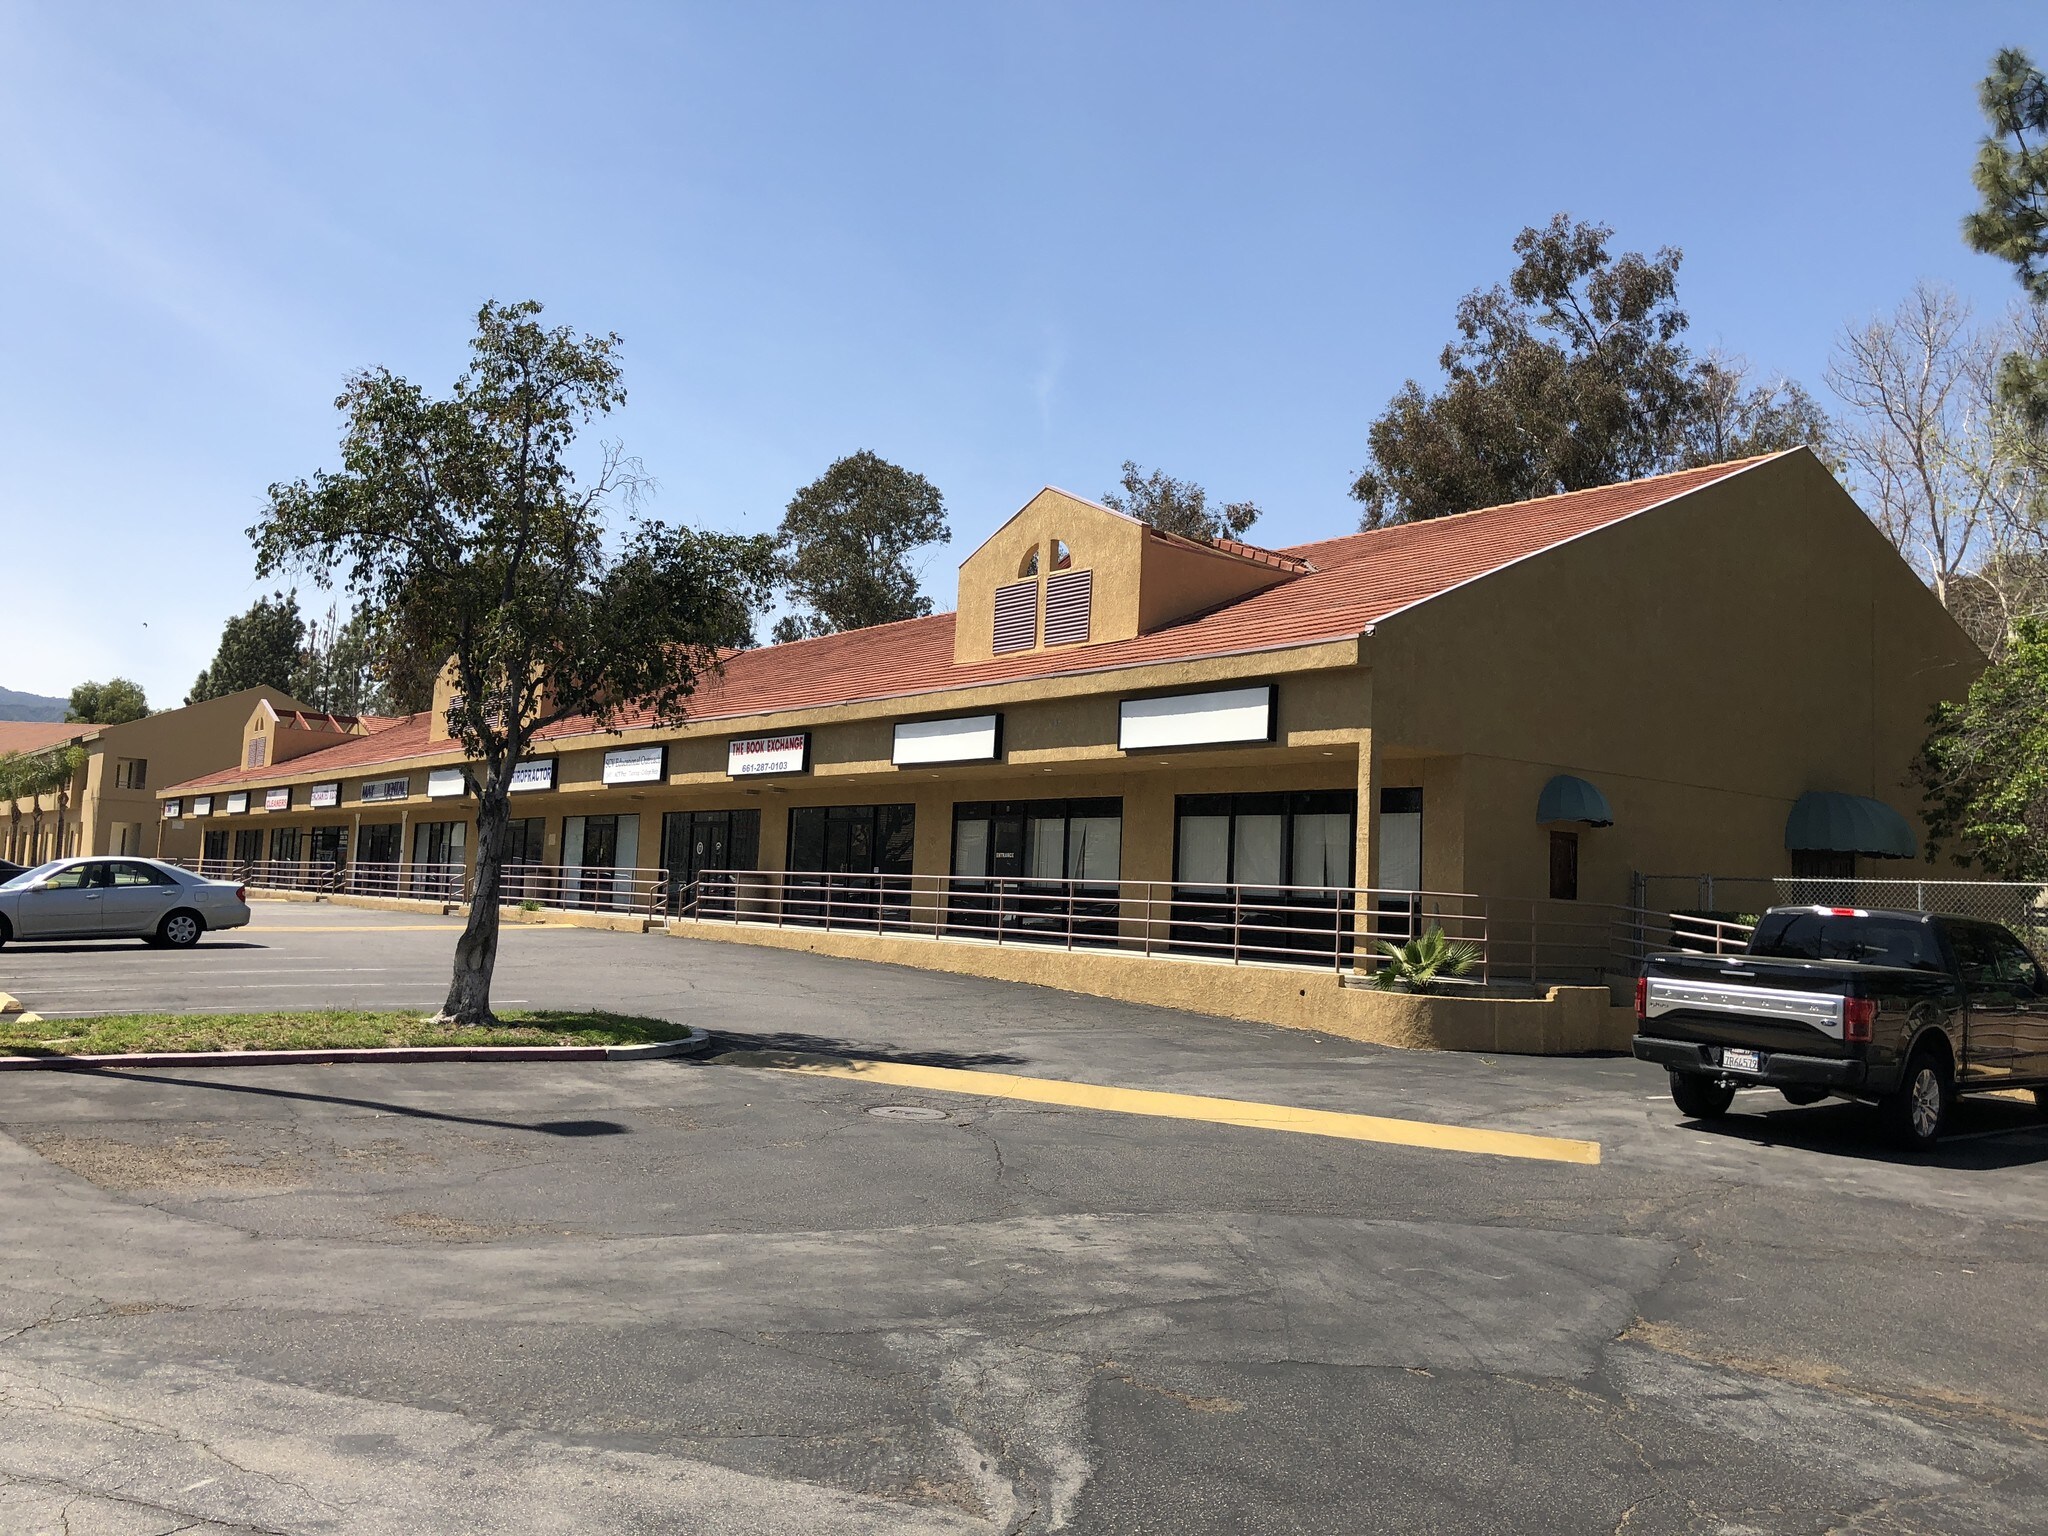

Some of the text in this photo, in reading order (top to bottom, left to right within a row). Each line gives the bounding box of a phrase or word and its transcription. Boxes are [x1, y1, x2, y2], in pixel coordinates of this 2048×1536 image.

[732, 736, 803, 756] THE BOOK EXCHANGE
[512, 766, 552, 783] HIROPRACTOR
[742, 761, 788, 773] 661-287-0103
[384, 780, 406, 796] DENTAL
[266, 798, 287, 808] CLEANERS
